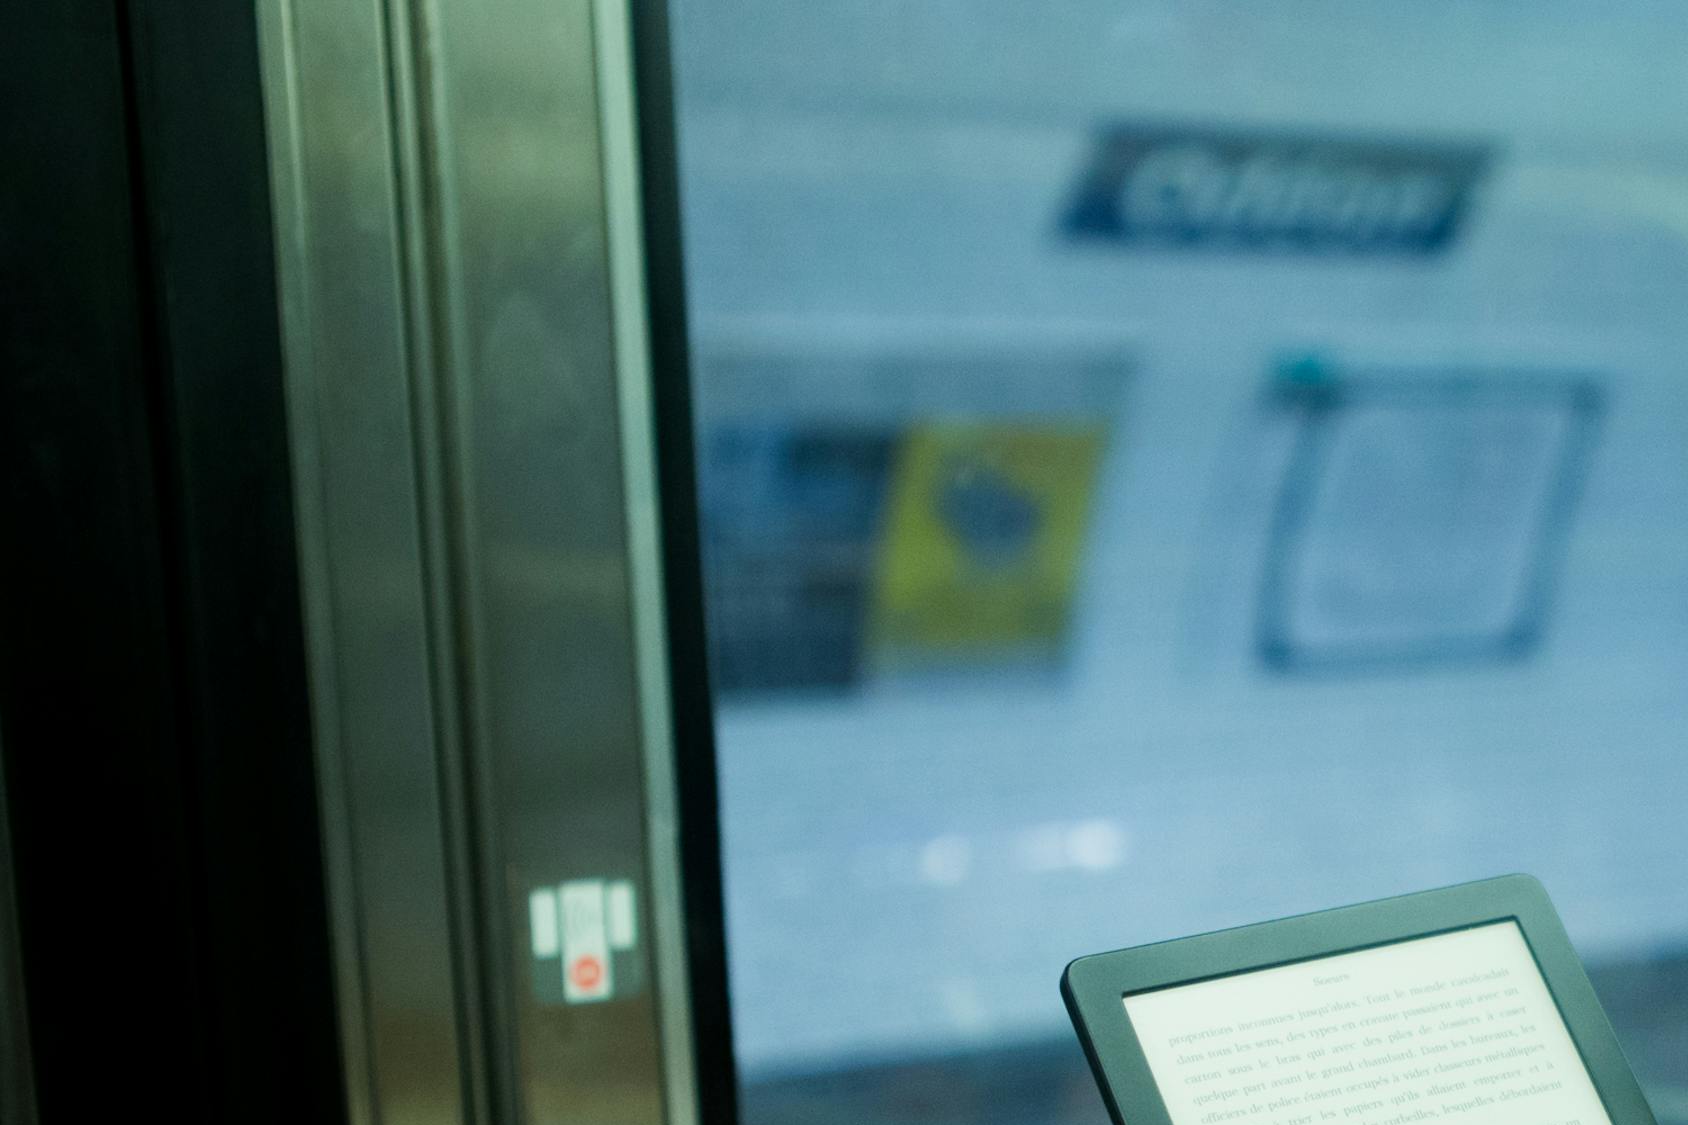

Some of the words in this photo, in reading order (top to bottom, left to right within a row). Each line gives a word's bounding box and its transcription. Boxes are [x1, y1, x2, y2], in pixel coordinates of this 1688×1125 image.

[1192, 1087, 1238, 1107] quelque
[1200, 1107, 1246, 1124] officiers
[1268, 1095, 1301, 1112] police
[1302, 1086, 1341, 1102] étaient
[1442, 1095, 1494, 1114] lesquelles
[1319, 1109, 1336, 1119] les
[1343, 1099, 1383, 1117] papiers
